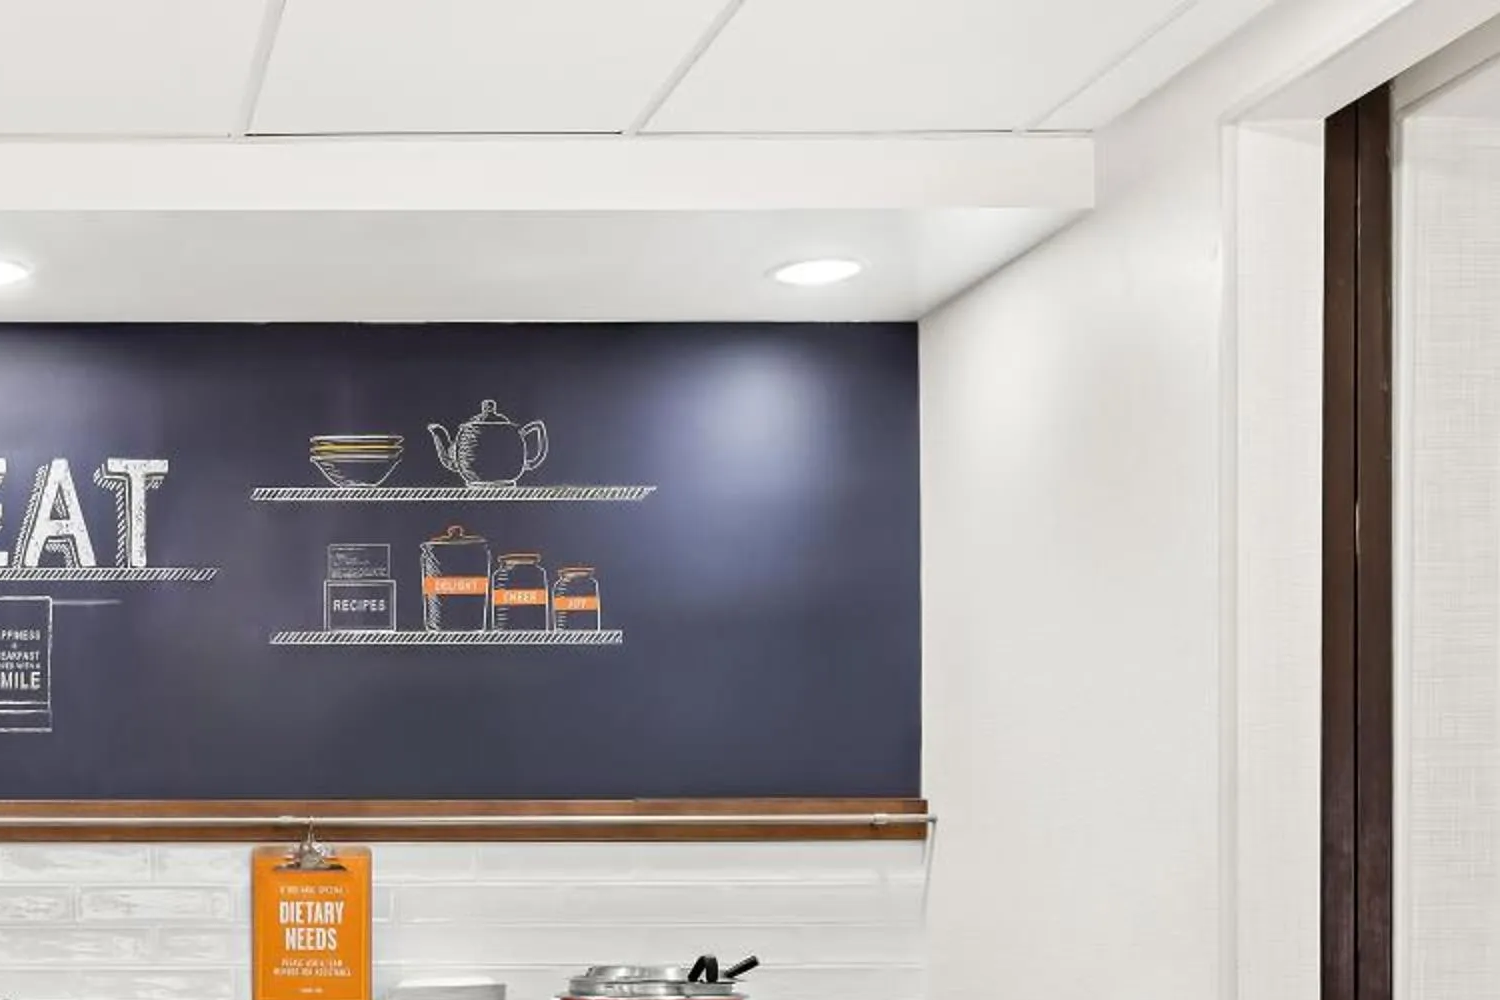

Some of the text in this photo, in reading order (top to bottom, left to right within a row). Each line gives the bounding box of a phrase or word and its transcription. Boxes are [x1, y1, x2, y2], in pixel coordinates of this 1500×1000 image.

[503, 592, 537, 604] CHEER
[333, 599, 386, 612] RECIPES
[567, 600, 587, 610] JOY
[279, 900, 345, 924] DIETARY
[285, 927, 337, 952] NEEDS
